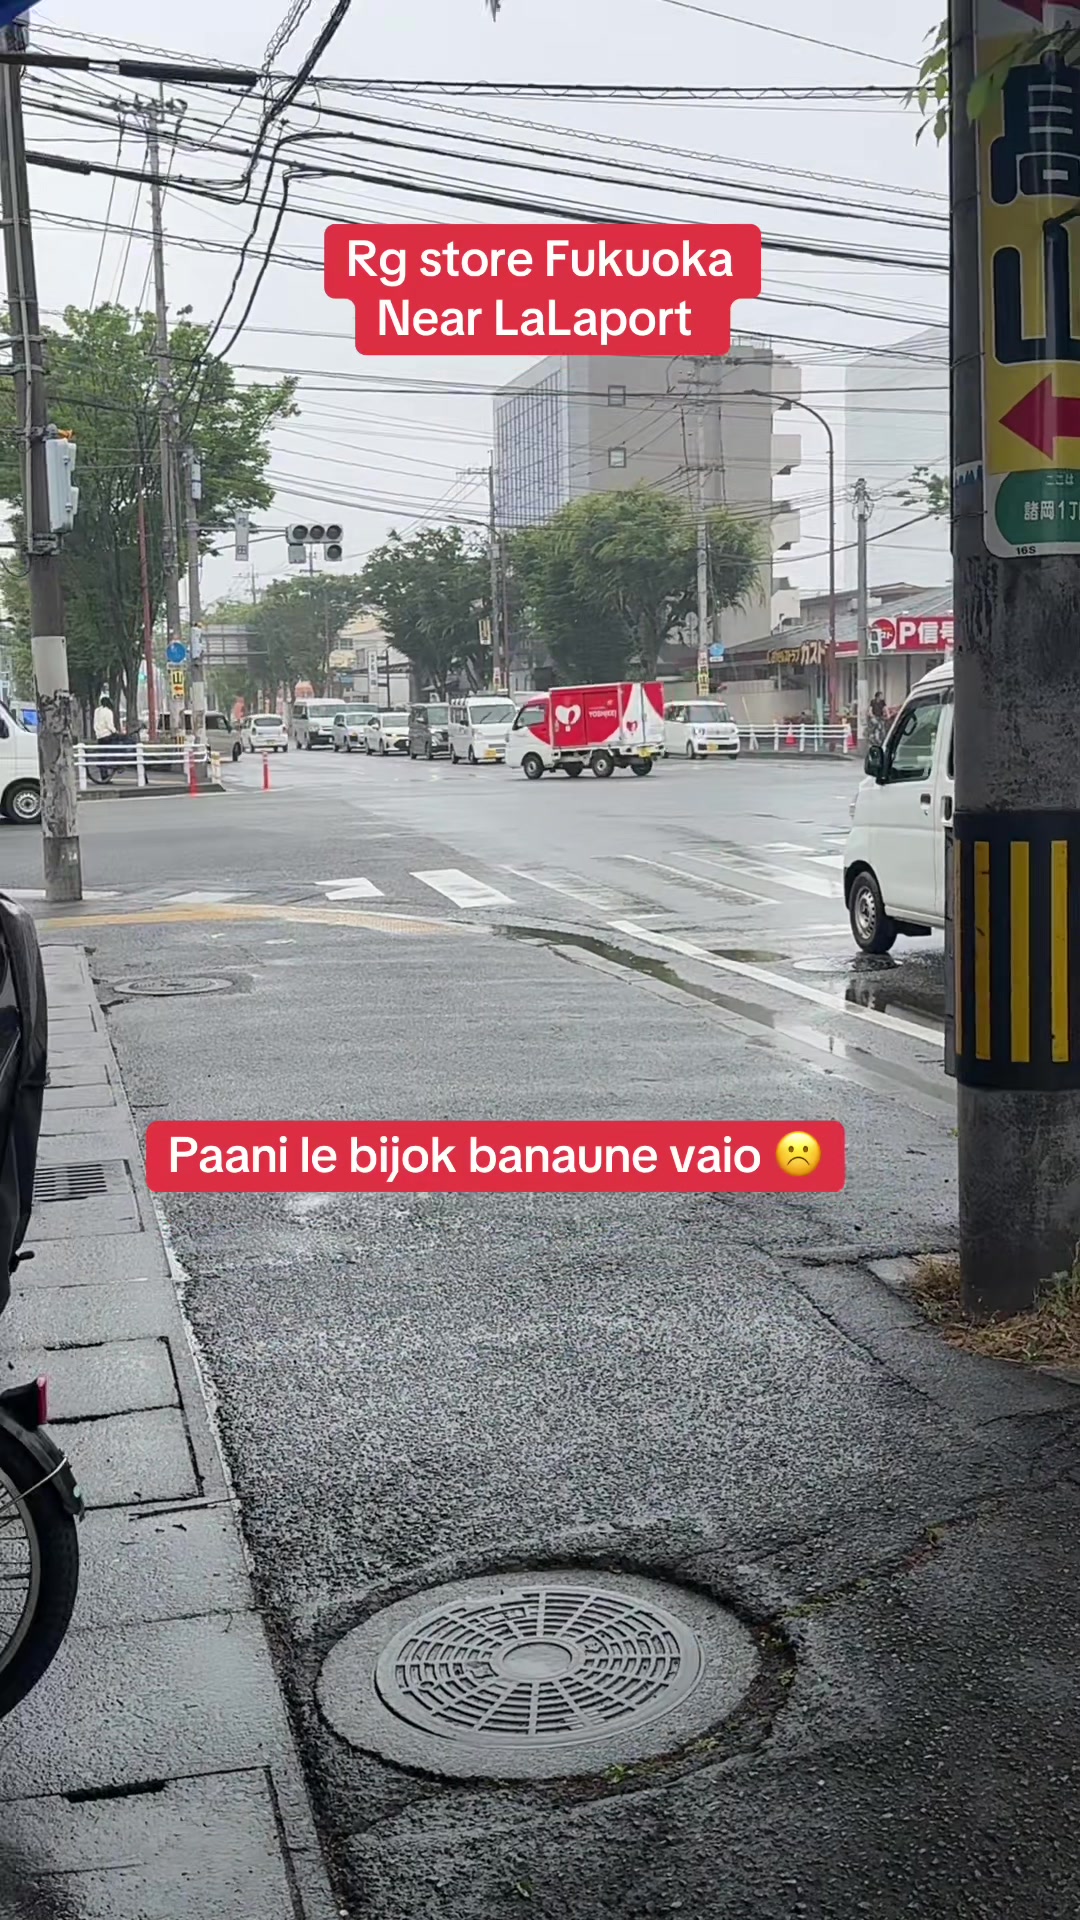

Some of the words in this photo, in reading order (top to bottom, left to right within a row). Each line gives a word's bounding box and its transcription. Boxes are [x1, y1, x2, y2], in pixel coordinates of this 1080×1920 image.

[1045, 473, 1074, 486] ここは
[1023, 500, 1080, 521] 諸岡1丁
[1016, 545, 1036, 555] 16S
[800, 640, 826, 666] ガスト
